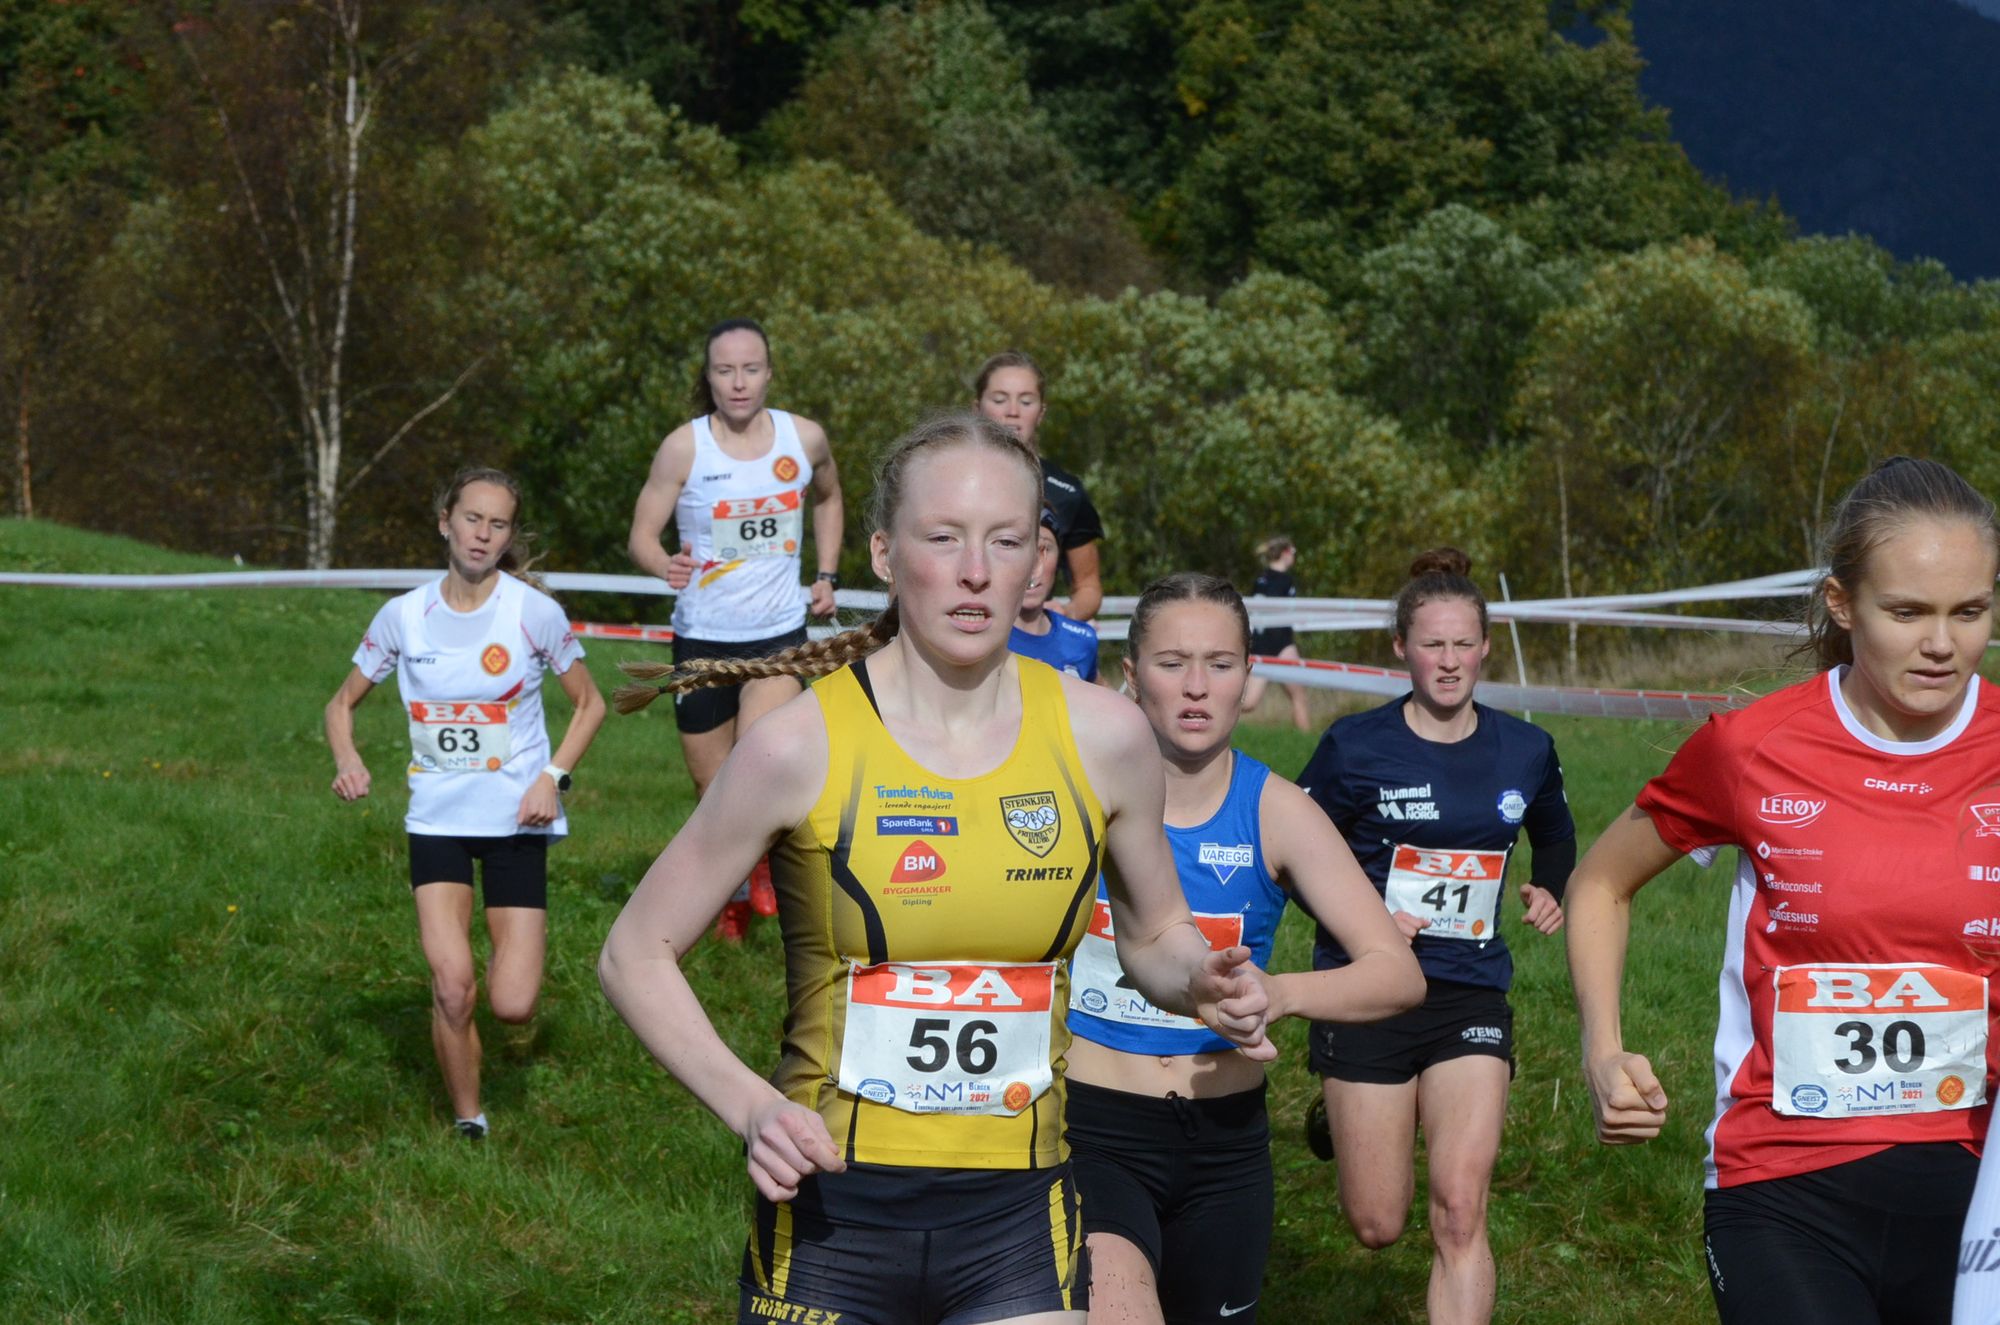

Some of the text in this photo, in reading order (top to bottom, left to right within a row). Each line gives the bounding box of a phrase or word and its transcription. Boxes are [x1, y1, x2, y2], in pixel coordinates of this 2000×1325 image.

[726, 497, 789, 517] BA
[740, 518, 778, 541] 68
[423, 703, 491, 722] BA
[437, 727, 480, 753] 63
[1380, 783, 1431, 801] hummel
[1864, 777, 1919, 793] CRAFT
[1004, 795, 1053, 809] STEINKJER
[1405, 802, 1435, 811] SPORT
[1760, 797, 1822, 816] LERØY
[1405, 810, 1440, 820] NORGE
[881, 818, 946, 832] SpareBank 1
[904, 855, 936, 871] BM
[1202, 849, 1250, 863] VAREGG
[1413, 852, 1488, 877] BA
[1005, 866, 1074, 881] TRIMTEX
[883, 885, 952, 895] BYGGMAKKER
[1421, 881, 1471, 914] 41
[885, 965, 1023, 1006] BA
[1807, 971, 1949, 1008] BA
[1461, 1026, 1503, 1040] STEND
[906, 1018, 999, 1074] 56
[1834, 1020, 1926, 1075] 30
[925, 1082, 962, 1101] NM
[969, 1093, 991, 1102] 2021
[1856, 1081, 1894, 1101] NM
[1902, 1090, 1923, 1100] 2021
[751, 1296, 842, 1325] TRIMTEX
